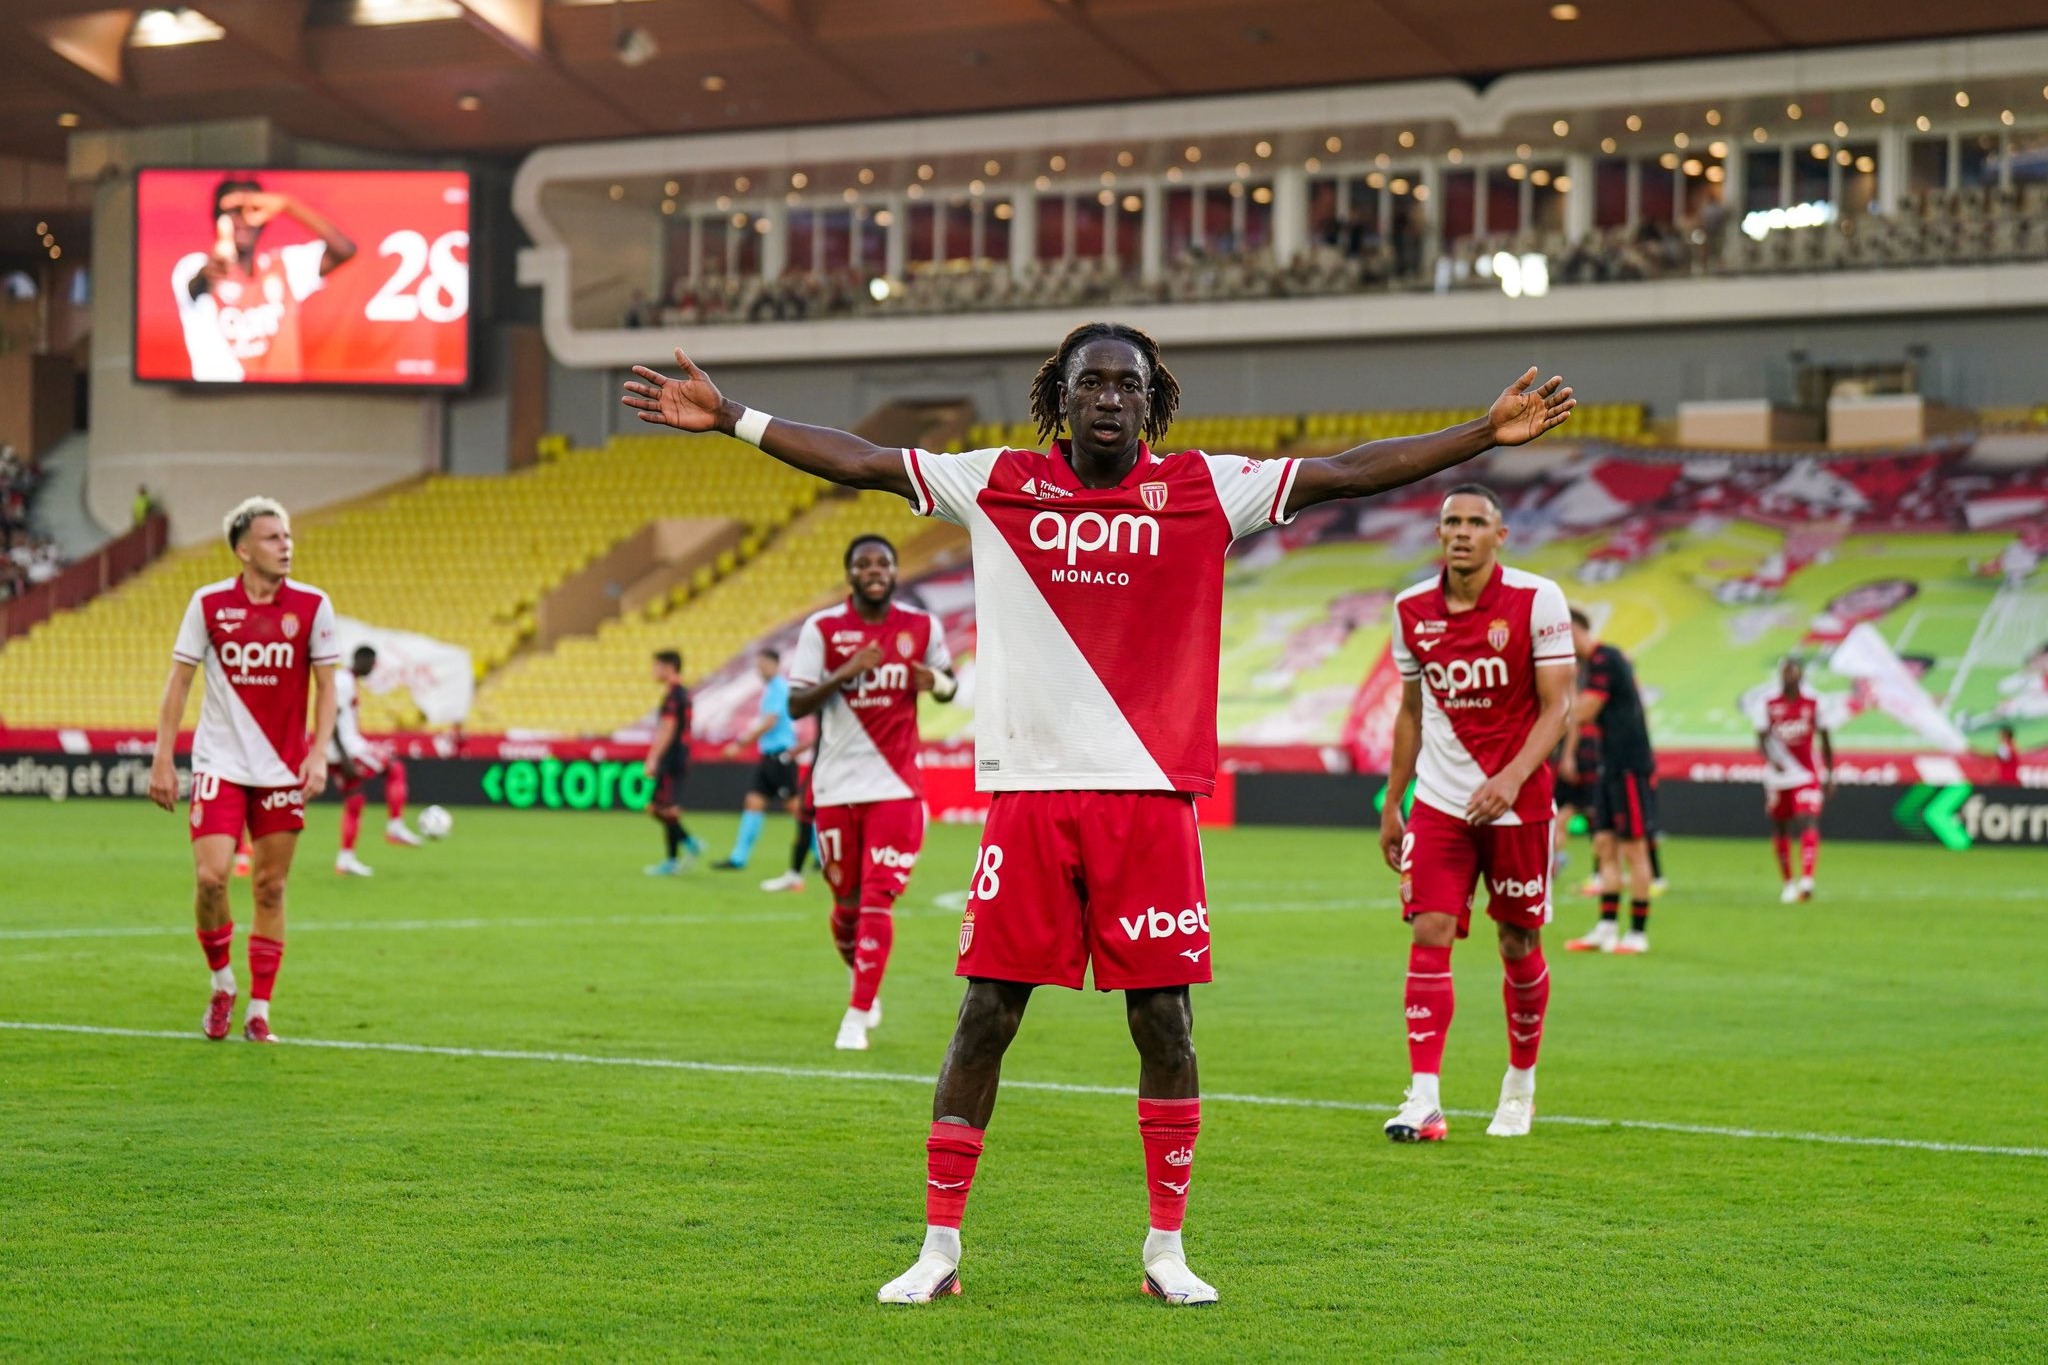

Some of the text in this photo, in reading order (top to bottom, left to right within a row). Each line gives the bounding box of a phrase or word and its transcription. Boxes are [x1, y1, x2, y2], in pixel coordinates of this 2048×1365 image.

[365, 229, 469, 323] 28
[1041, 480, 1074, 498] Triangle
[1029, 511, 1160, 566] apm
[1051, 569, 1130, 586] MONACO
[221, 641, 294, 675] apm
[231, 674, 279, 686] MONACO
[1424, 656, 1509, 698] apm
[1444, 698, 1493, 709] MONACO
[72, 761, 104, 795] et
[193, 773, 220, 801] 10
[504, 756, 657, 812] etoro
[261, 789, 304, 811] vbe
[870, 845, 918, 868] vbe
[1119, 901, 1210, 941] vbet
